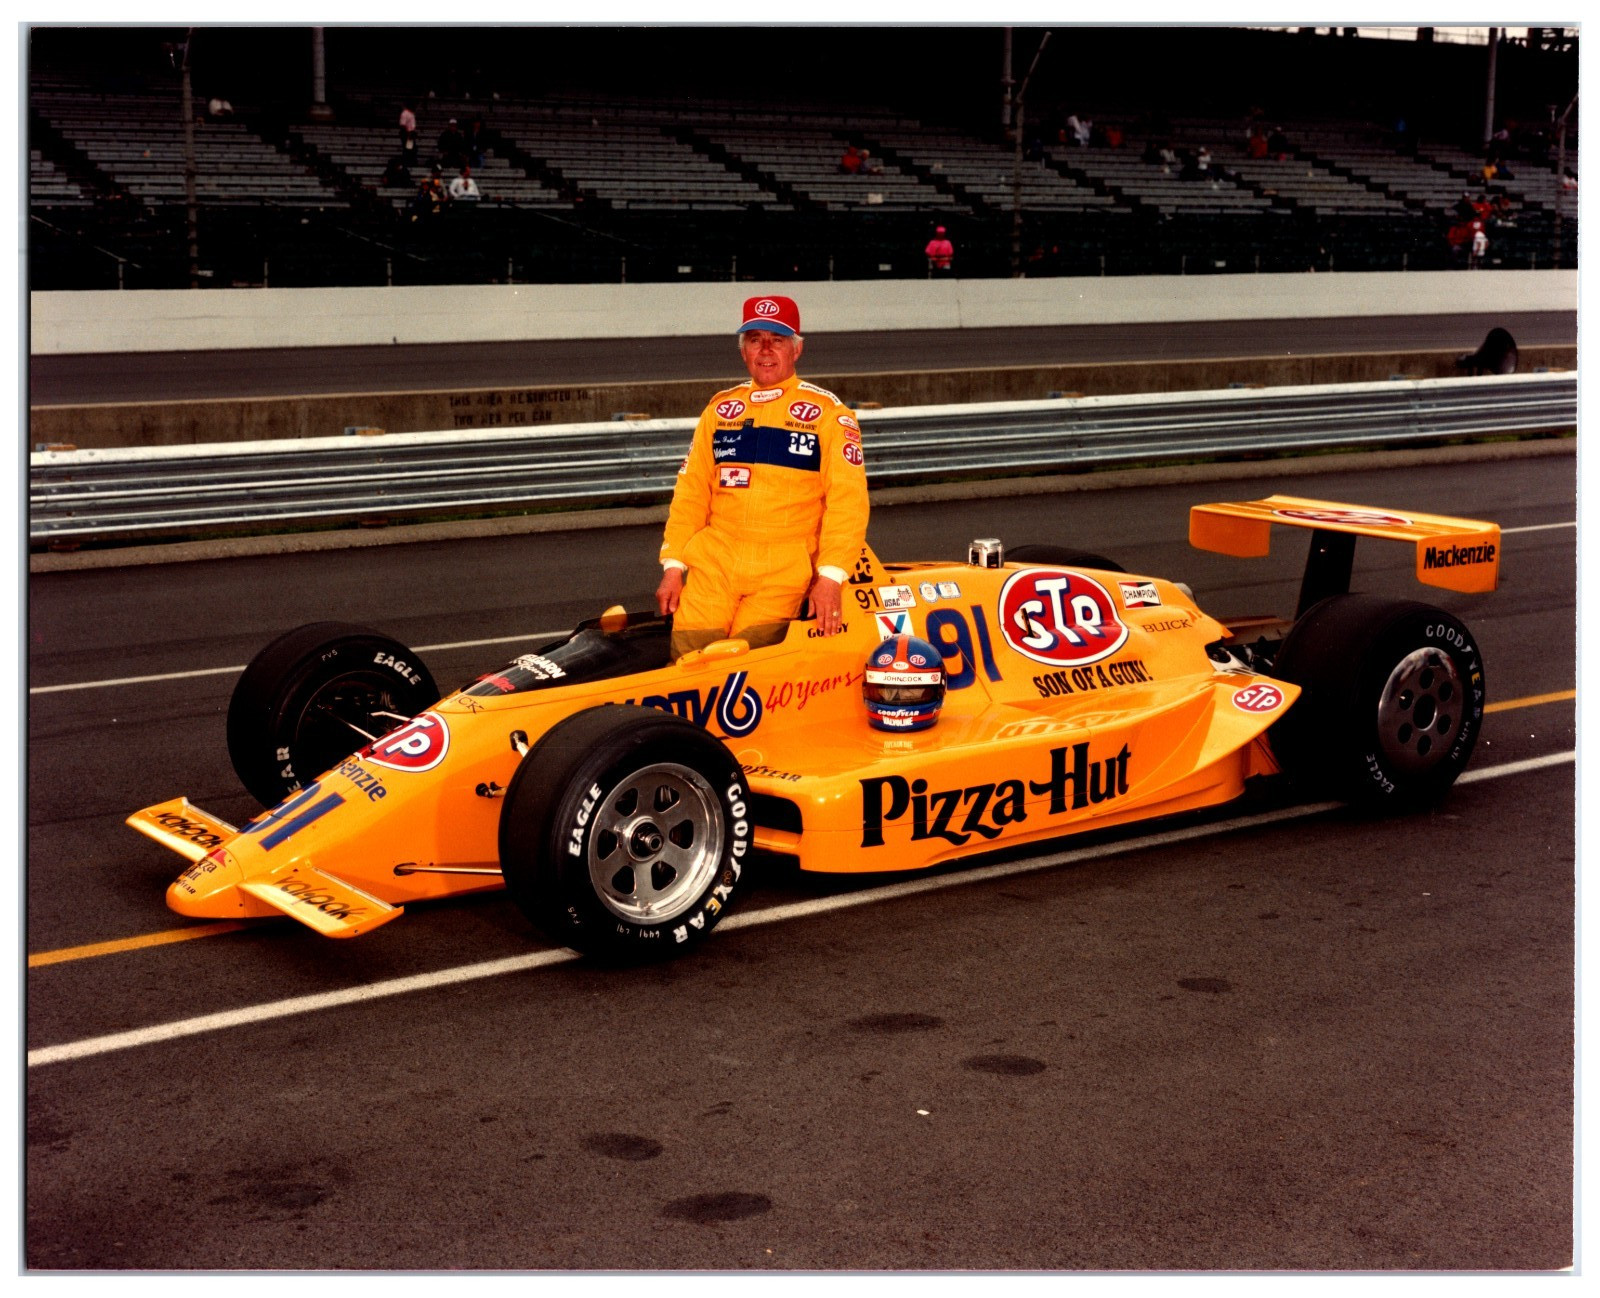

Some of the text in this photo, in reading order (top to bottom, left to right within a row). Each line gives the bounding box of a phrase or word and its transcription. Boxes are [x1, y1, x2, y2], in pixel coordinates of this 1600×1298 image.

[757, 302, 777, 314] STP
[717, 401, 744, 419] STP
[791, 403, 820, 419] STP
[788, 432, 816, 456] PPG
[845, 444, 863, 462] STP
[1423, 541, 1496, 570] Mackenzie
[855, 588, 880, 610] 91
[884, 597, 901, 608] USAC
[1124, 589, 1157, 600] CHAMPION
[1012, 576, 1102, 650] STP
[1142, 619, 1193, 633] BUICK
[926, 603, 1004, 691] 91
[373, 651, 422, 685] EAGLE
[1033, 660, 1154, 698] SON OF A GUN!
[1425, 623, 1483, 719] GOODYEAR
[765, 672, 863, 714] 40 Years
[1236, 686, 1277, 709] STP
[877, 709, 920, 718] GOODYEAR
[882, 716, 914, 727] VALVOLINE
[371, 716, 436, 755] TP
[339, 760, 387, 802] enzie
[1366, 753, 1395, 794] EAGLE
[858, 741, 1132, 848] Pizza Hut
[568, 782, 602, 858] EAGLE
[672, 782, 749, 944] GOODYEAR
